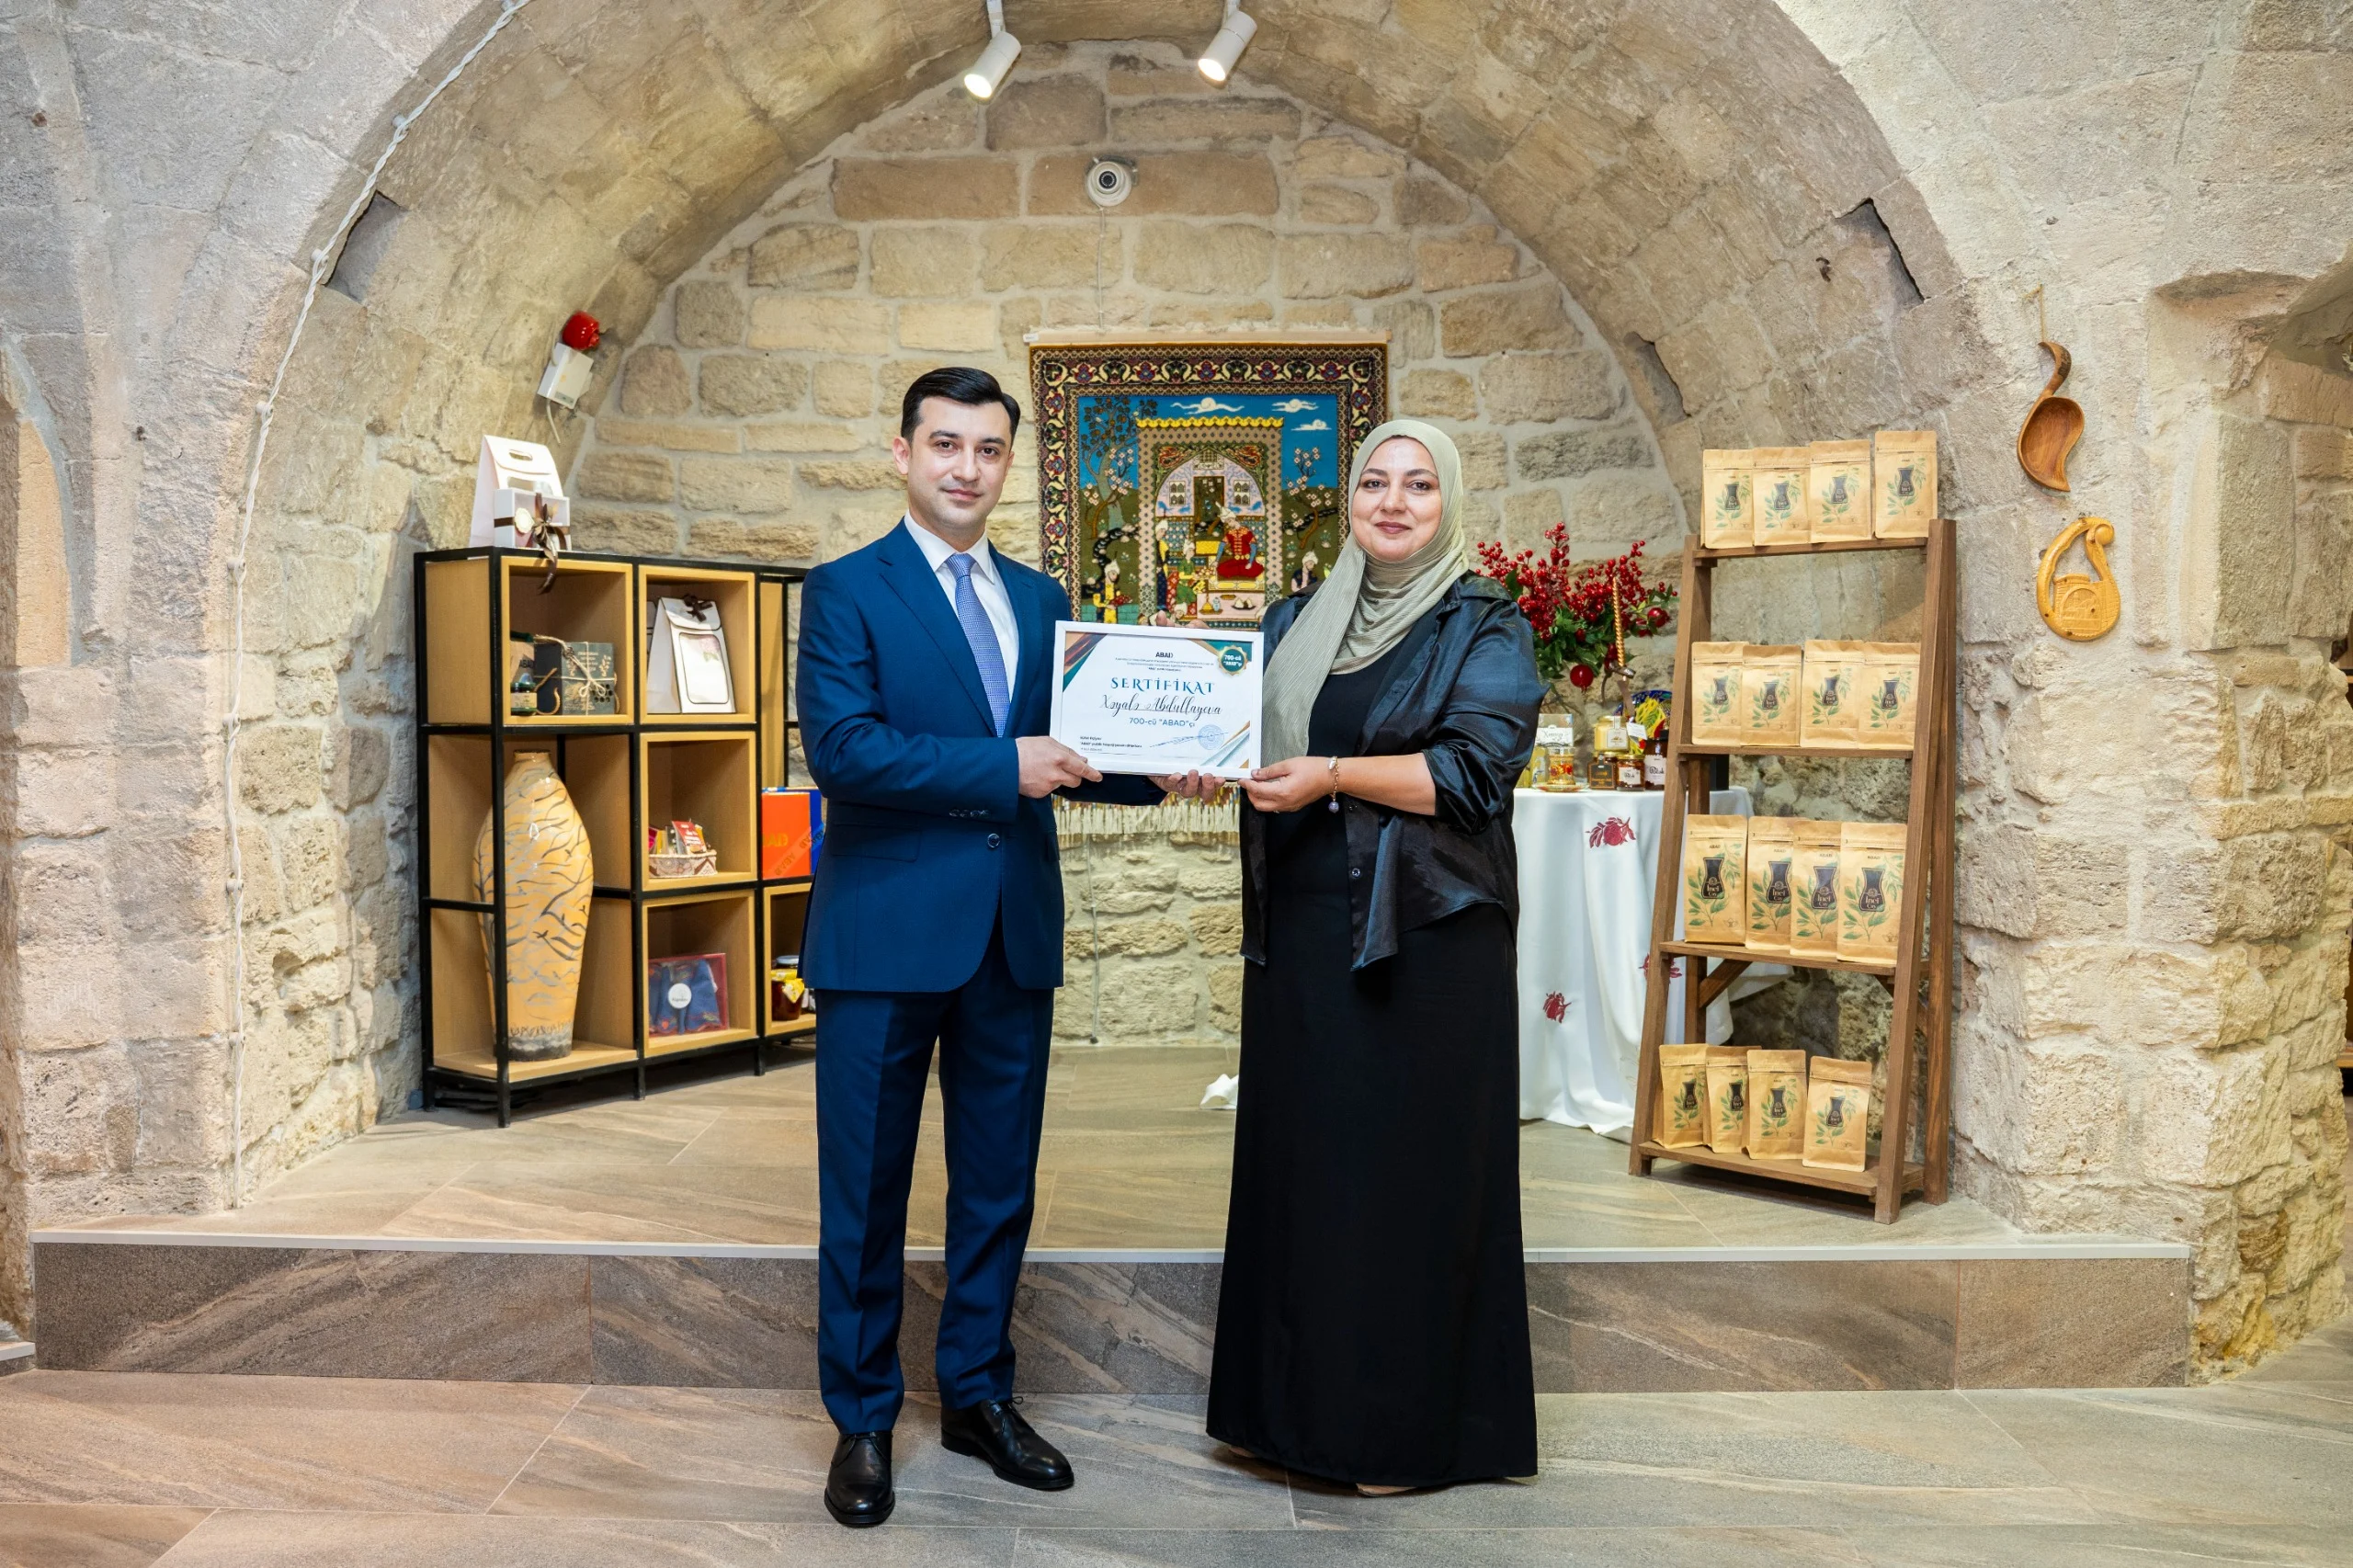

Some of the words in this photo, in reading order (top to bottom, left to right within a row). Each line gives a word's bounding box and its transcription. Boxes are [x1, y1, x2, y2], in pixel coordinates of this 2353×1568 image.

[1110, 676, 1214, 695] SERTİFİKAT
[1145, 694, 1222, 721] Abdullayeva
[1129, 717, 1157, 725] 700-cü
